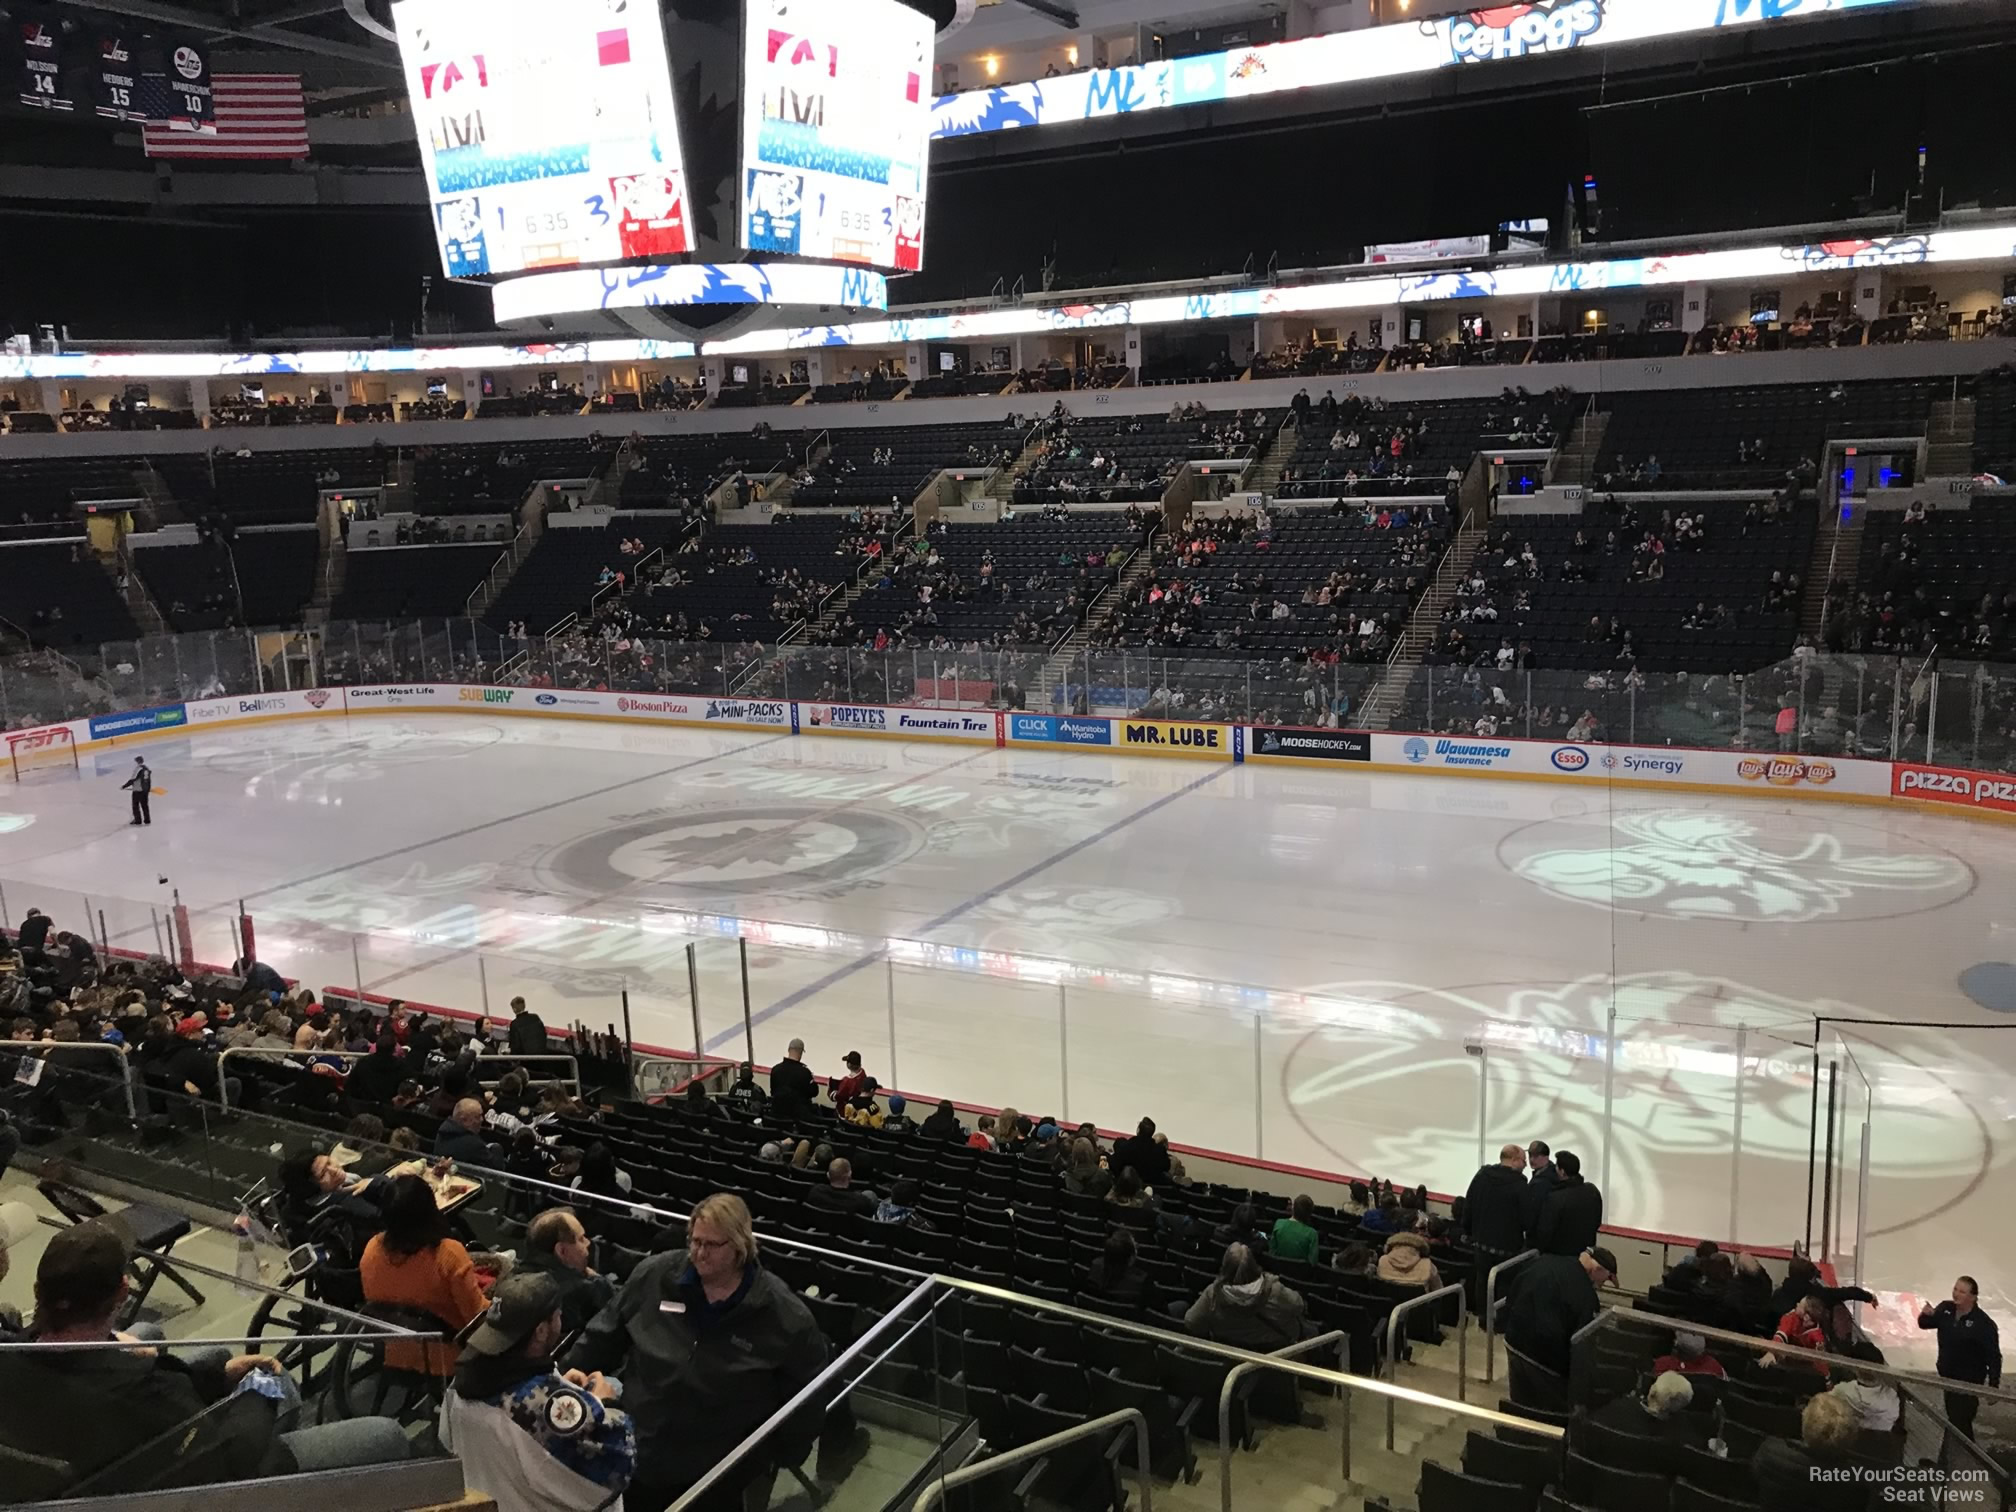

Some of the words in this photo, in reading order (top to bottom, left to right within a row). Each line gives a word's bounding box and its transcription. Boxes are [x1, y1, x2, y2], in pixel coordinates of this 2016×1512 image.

[34, 74, 55, 94] 14
[110, 87, 130, 106] 15
[184, 95, 202, 113] 10
[584, 195, 610, 226] 3
[881, 207, 894, 235] 3
[1247, 496, 1262, 507] 106
[1564, 489, 1582, 500] 107
[972, 501, 986, 512] 105
[351, 687, 414, 697] Great-West
[416, 687, 435, 695] Life
[459, 687, 514, 703] SUBWAY
[630, 700, 662, 712] Boston
[663, 701, 688, 713] Pizza
[721, 702, 784, 718] MINI-PACKS
[830, 706, 885, 724] POPEYE'S
[900, 715, 960, 730] Fountain
[962, 718, 987, 732] Tire
[1018, 719, 1047, 731] CLICK
[1072, 724, 1106, 734] Manitoba
[1072, 731, 1095, 741] Hydro
[1126, 724, 1165, 744] MR.
[1169, 726, 1219, 748] LUBE
[1435, 739, 1511, 758] Wawanesa
[1445, 756, 1492, 766] Insurance
[1557, 752, 1584, 765] Esso
[1623, 756, 1683, 774] Synergy
[1900, 770, 1971, 794] pizza
